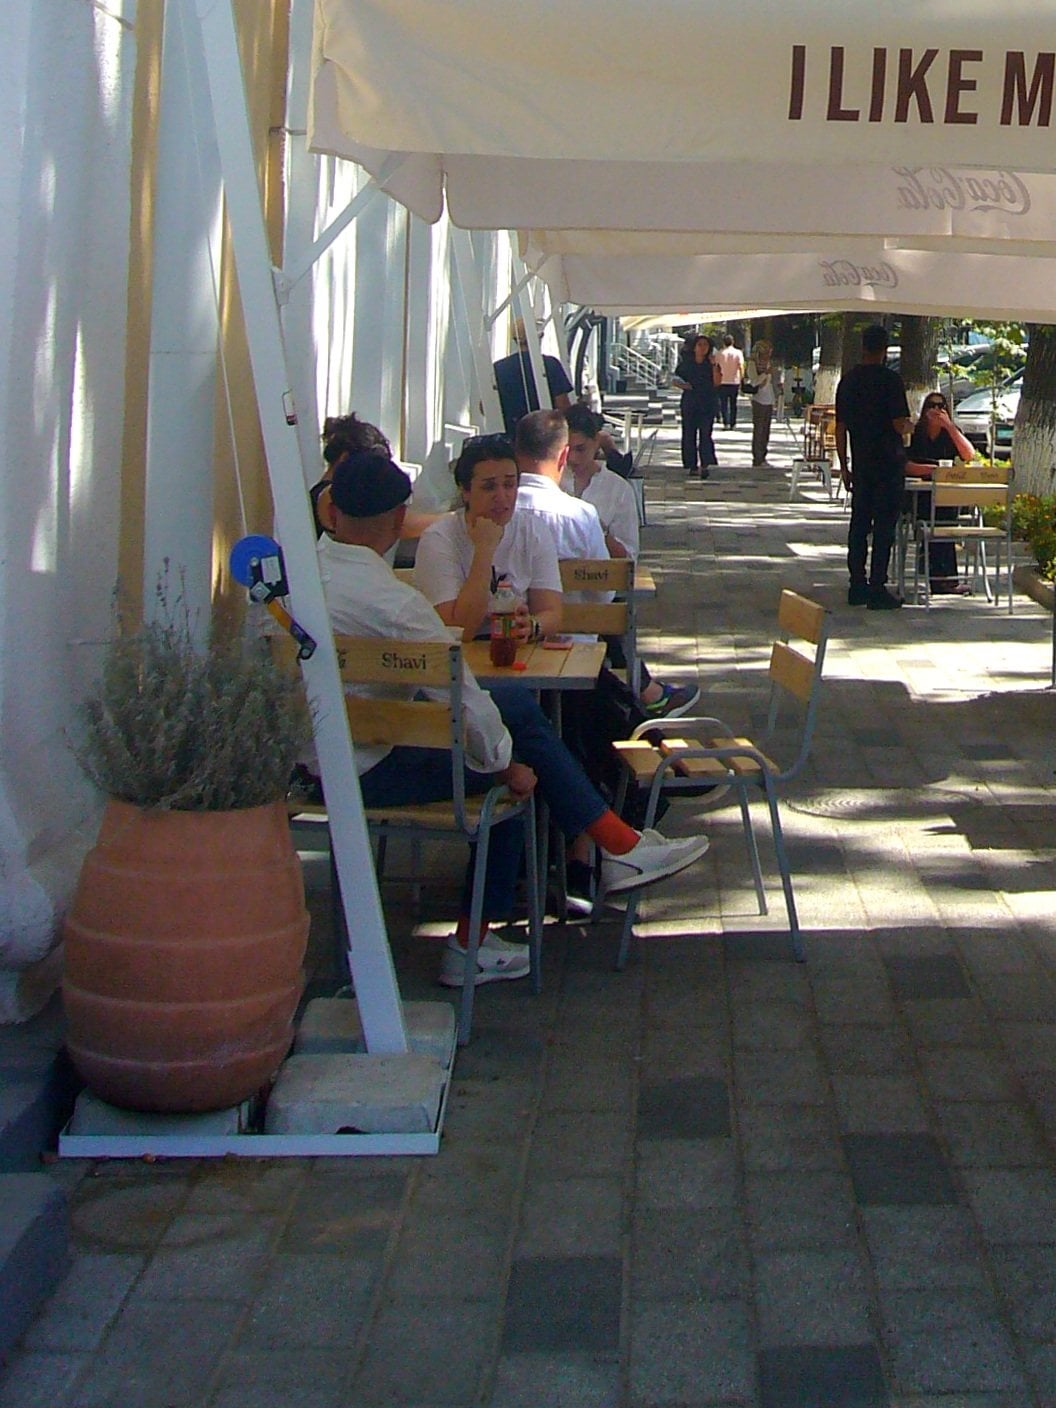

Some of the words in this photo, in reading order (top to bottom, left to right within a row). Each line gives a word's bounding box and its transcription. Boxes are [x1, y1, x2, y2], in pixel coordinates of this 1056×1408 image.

[788, 45, 806, 120] I
[826, 46, 983, 124] LIKE
[382, 652, 426, 670] Shavi
